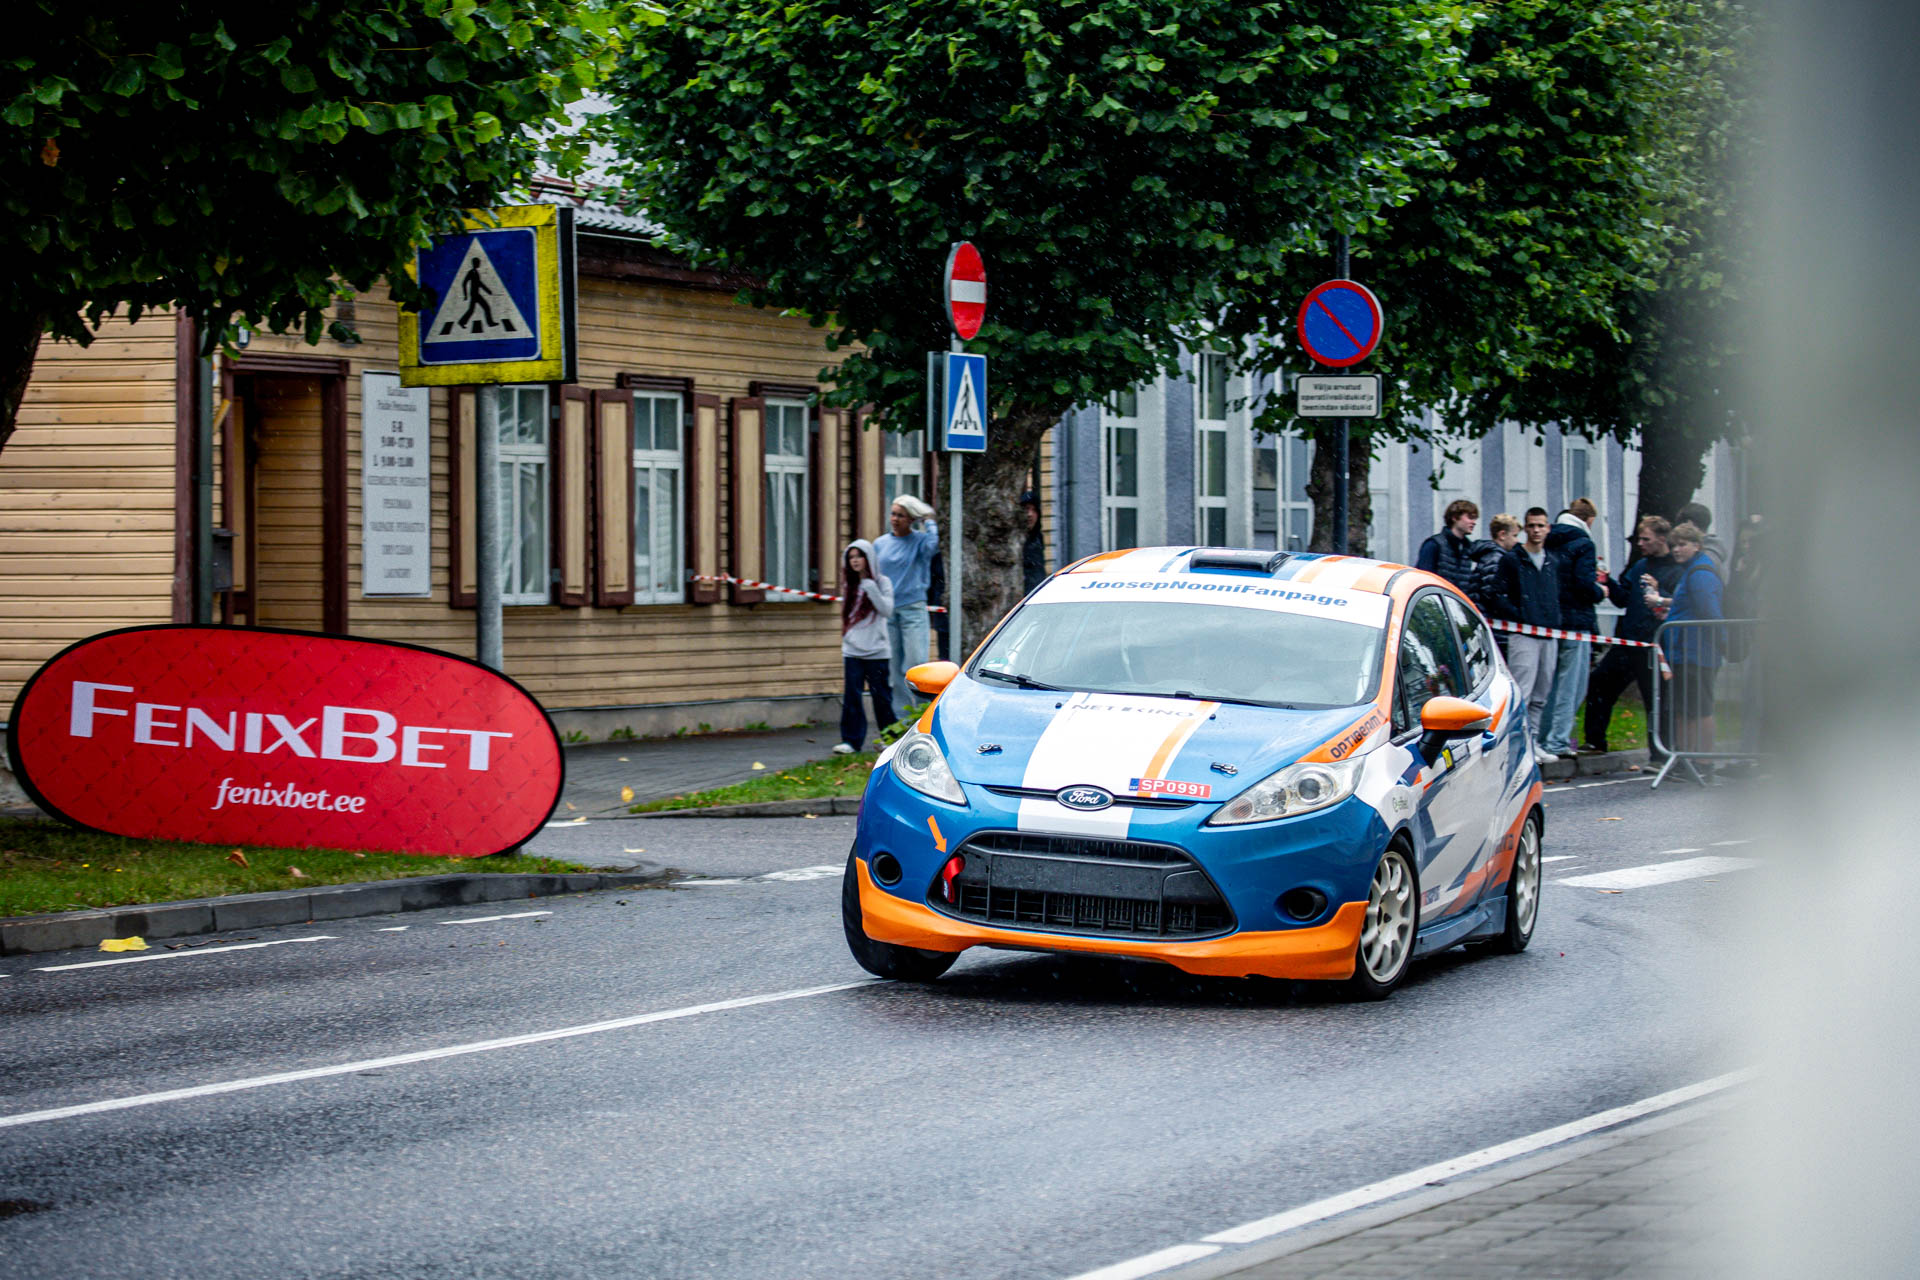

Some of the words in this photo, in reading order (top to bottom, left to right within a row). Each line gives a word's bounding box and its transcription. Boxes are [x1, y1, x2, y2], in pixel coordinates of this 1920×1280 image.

[1334, 383, 1362, 391] arvatud
[1081, 580, 1348, 607] JoosepNooniFanpage
[210, 777, 366, 813] fenixbet.ee
[1166, 782, 1205, 796] 0991
[1069, 790, 1101, 804] Ford
